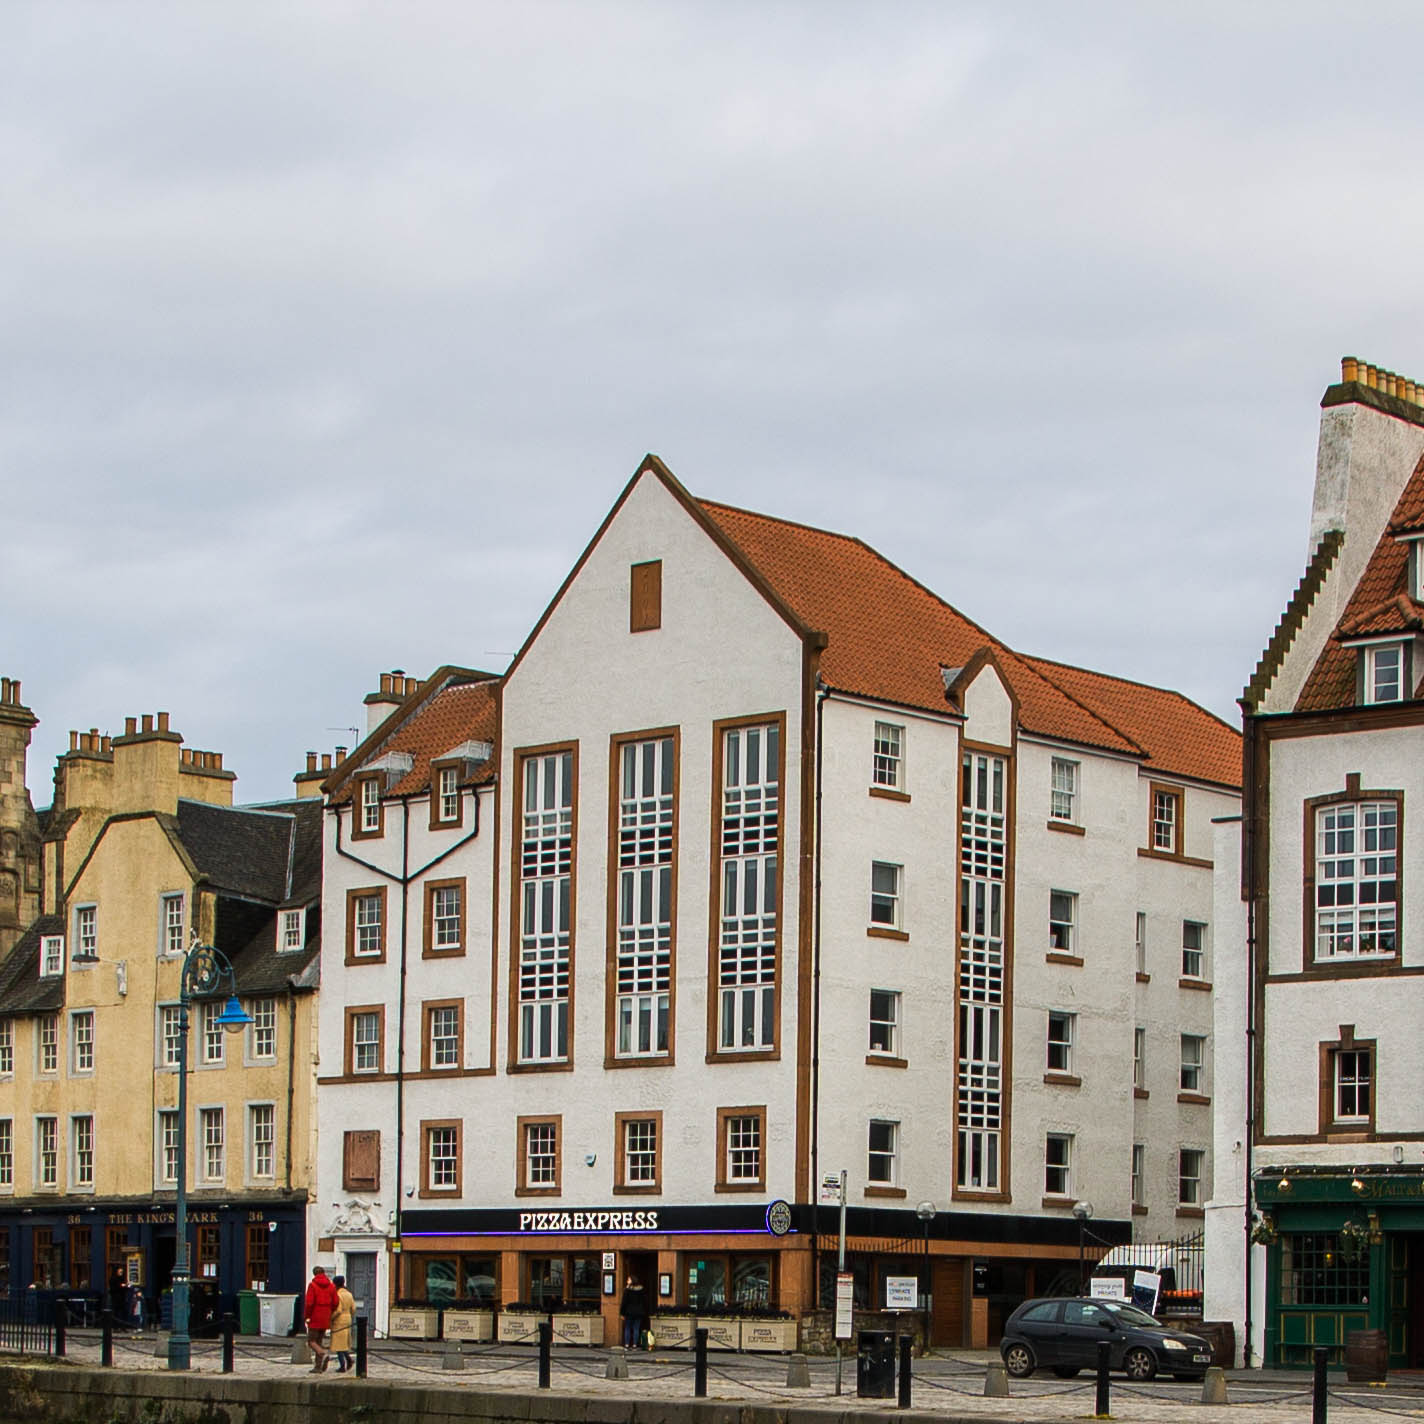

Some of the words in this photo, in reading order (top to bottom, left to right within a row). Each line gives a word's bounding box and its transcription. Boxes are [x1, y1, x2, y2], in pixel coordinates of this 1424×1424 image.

[67, 1214, 81, 1225] 36
[109, 1213, 133, 1224] THE
[137, 1212, 175, 1224] KING'S
[248, 1210, 264, 1222] 36
[519, 1211, 659, 1231] PIZZAEXPRESS
